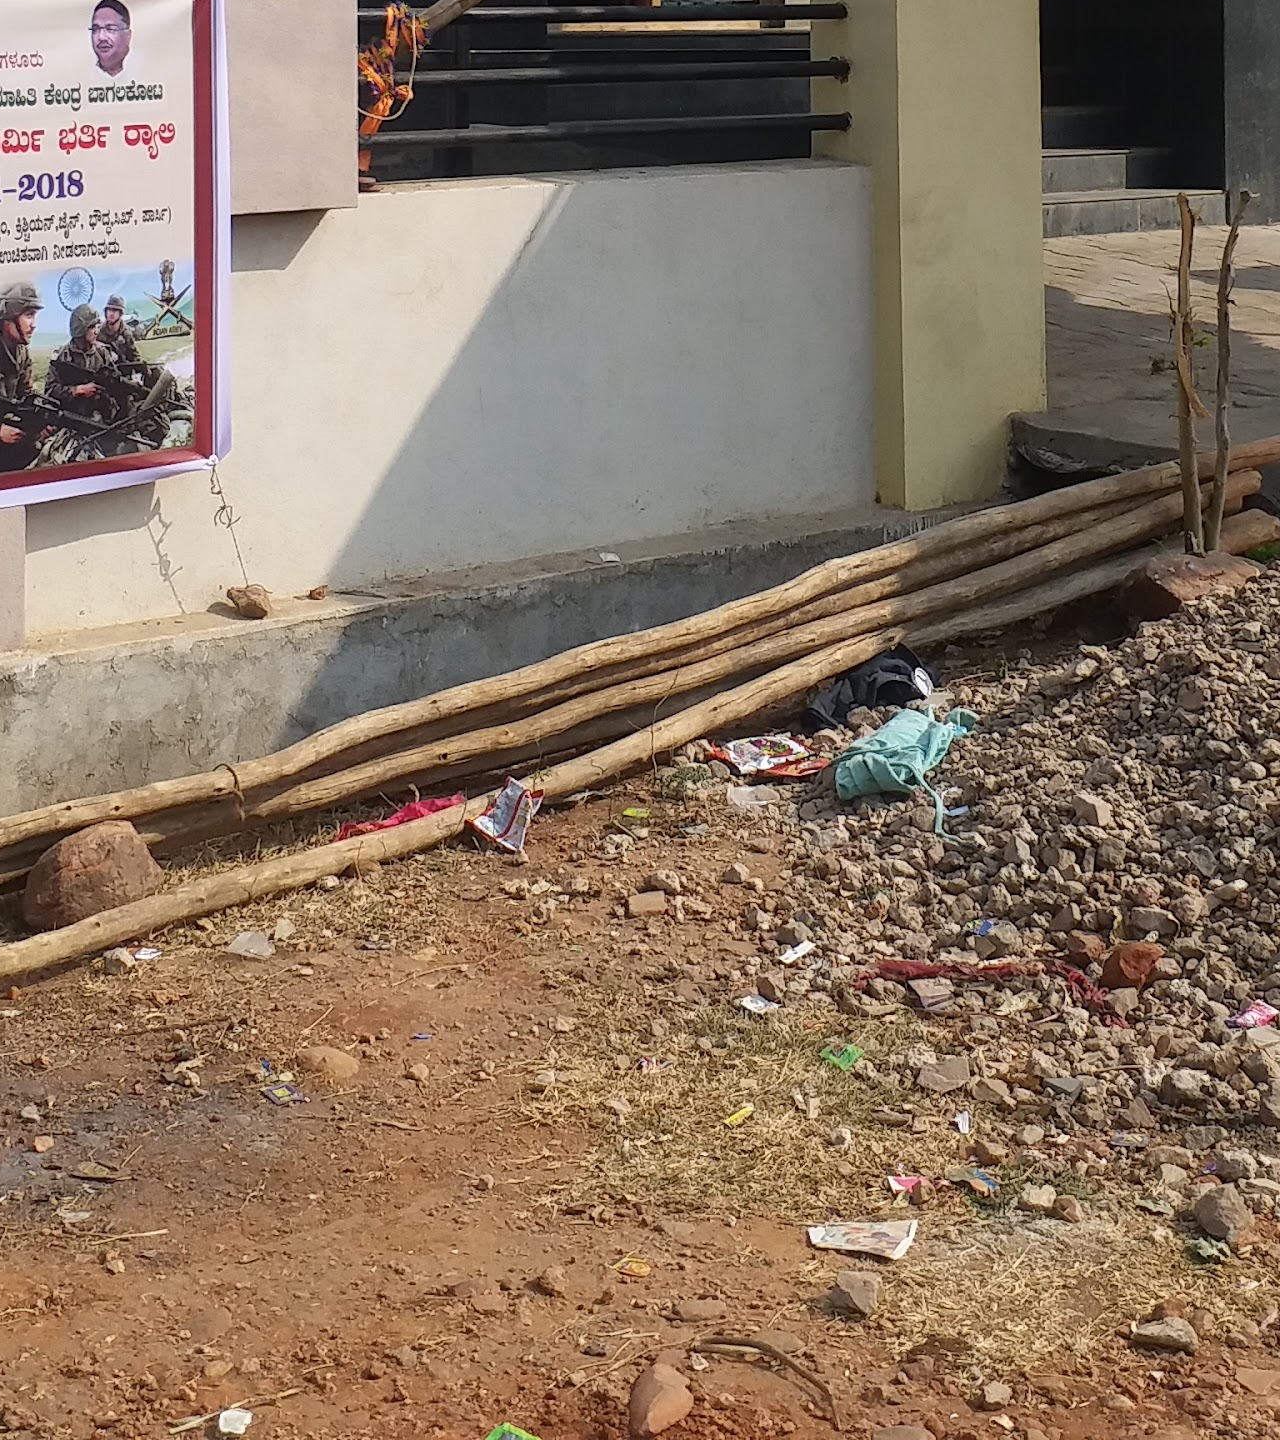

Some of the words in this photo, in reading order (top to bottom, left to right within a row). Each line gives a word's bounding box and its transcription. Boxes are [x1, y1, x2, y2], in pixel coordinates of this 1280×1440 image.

[44, 82, 82, 112] ಕೇಂದ್ರ
[88, 80, 163, 102] ಬಾಗಲಕೋಟ
[58, 120, 111, 156] ಭರ್ತಿ
[52, 237, 123, 261] ನೀಡಲಾಗುವುದು.
